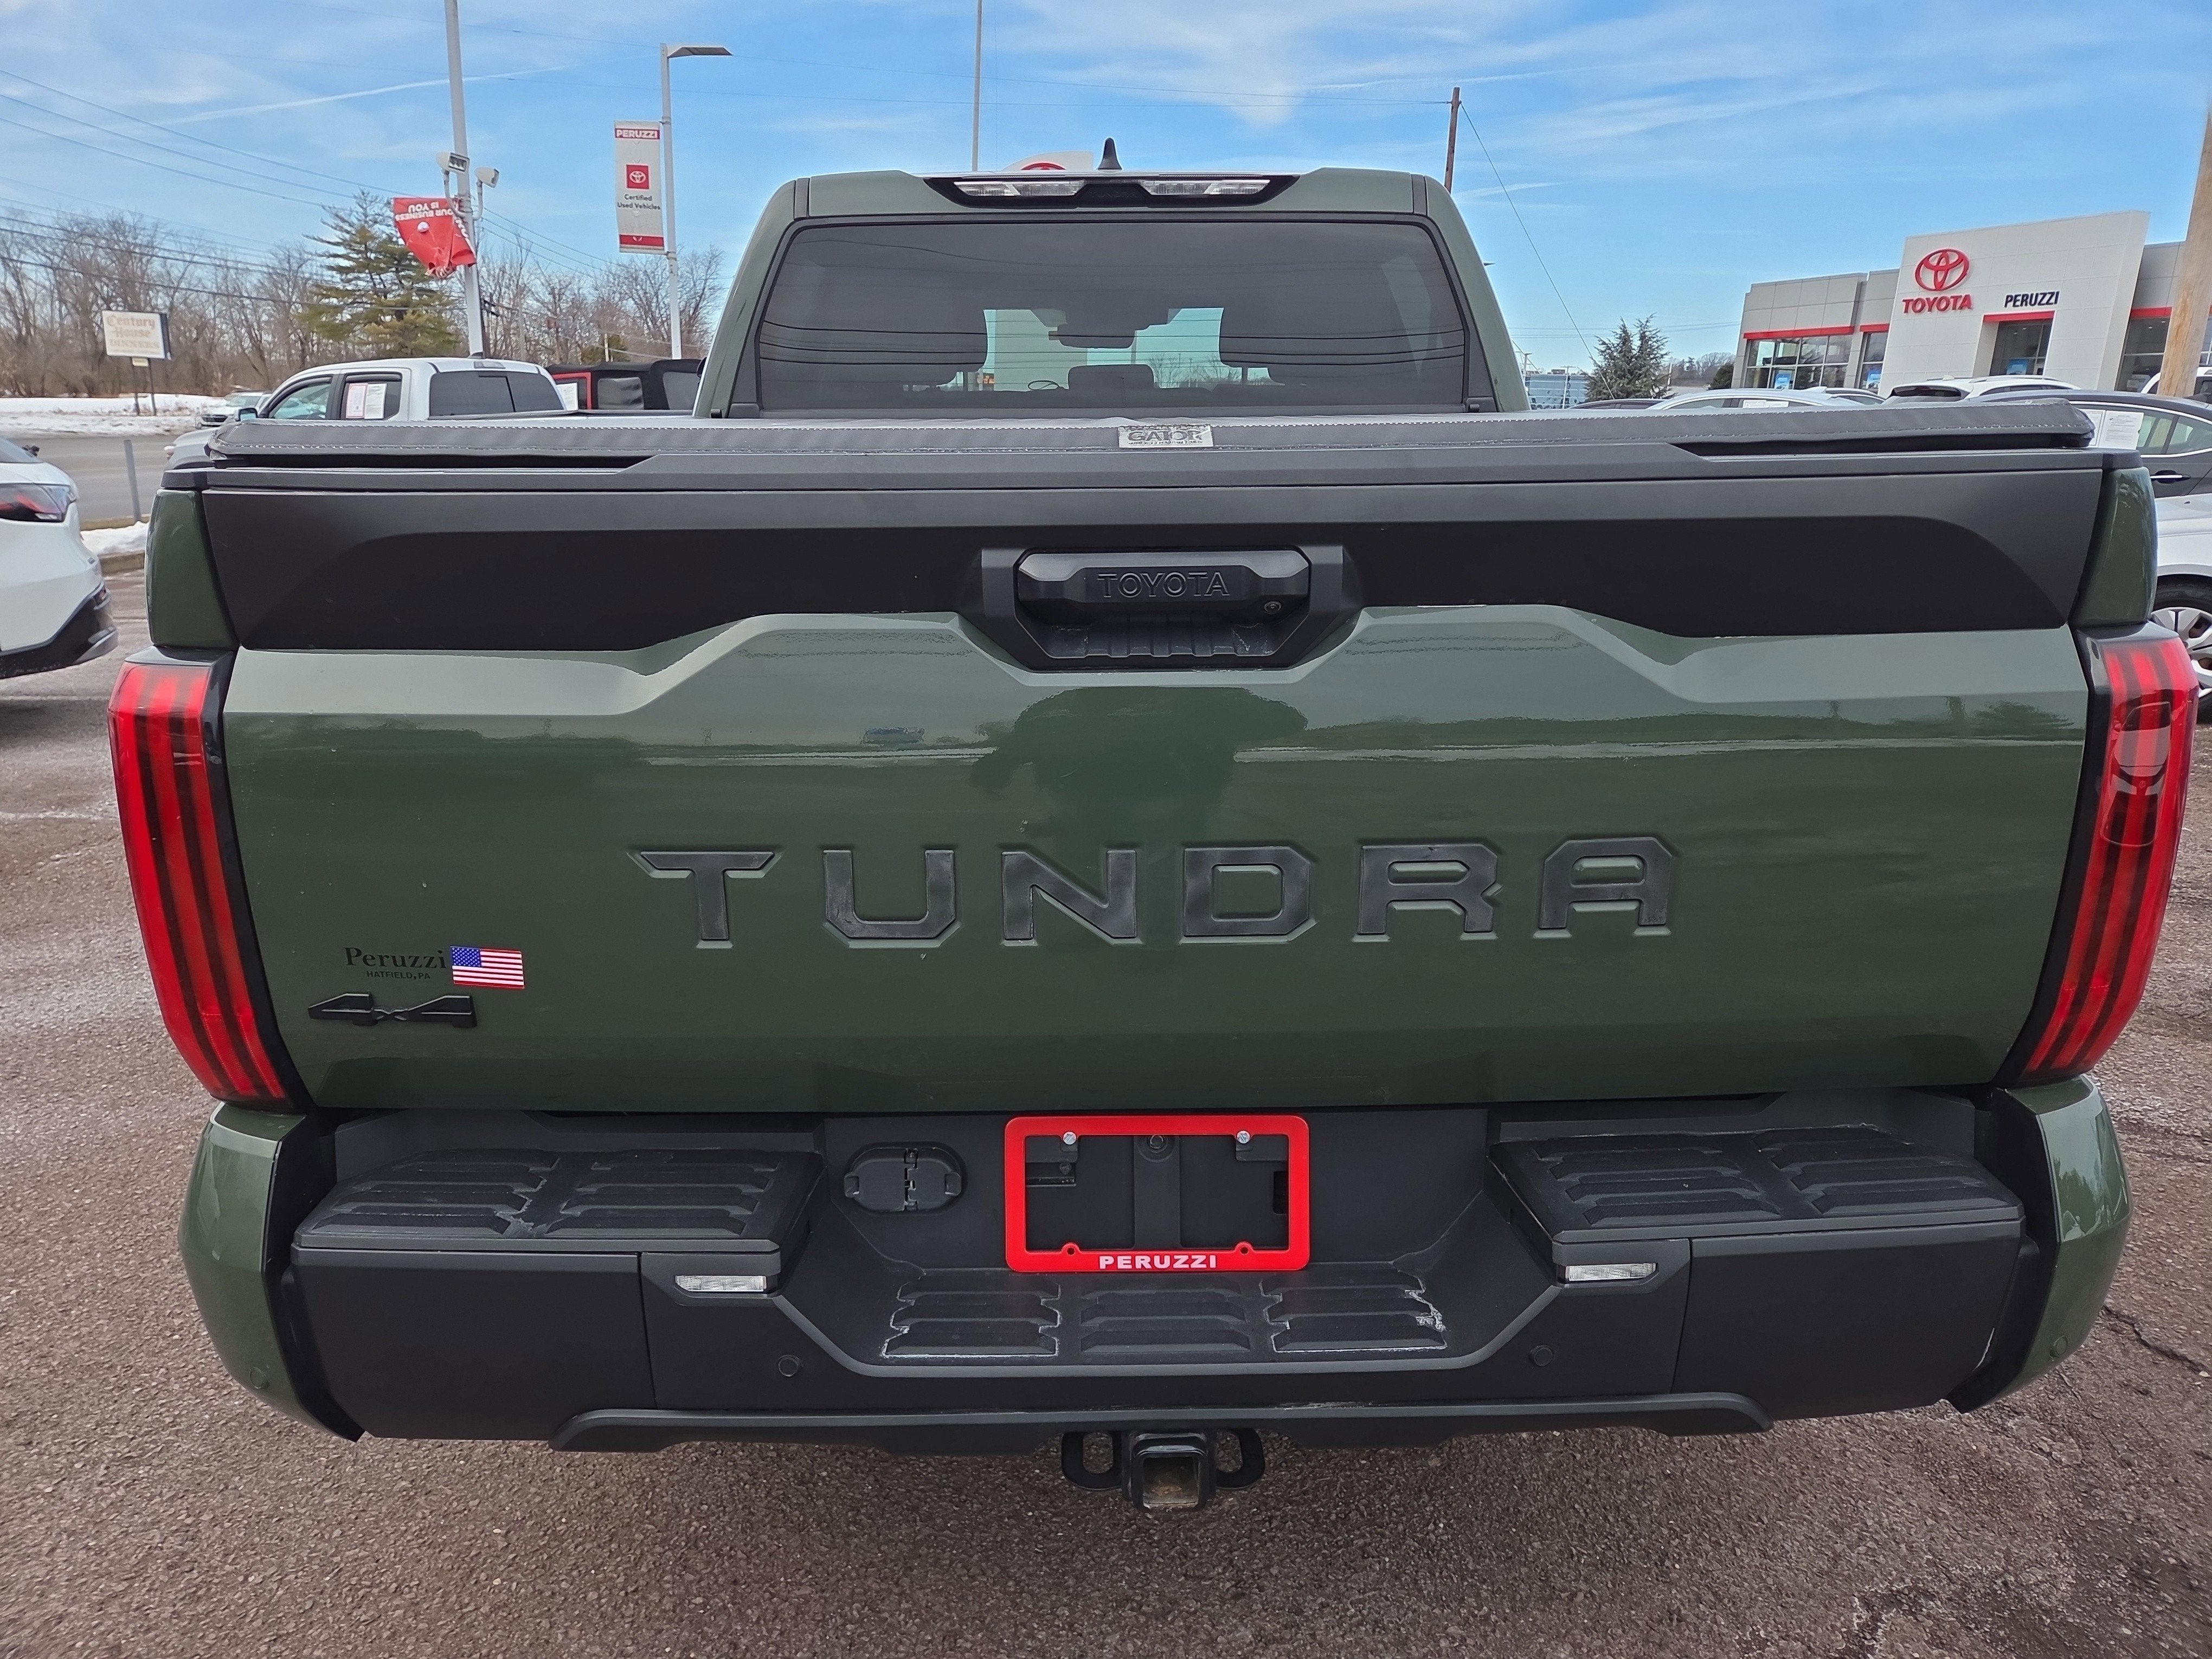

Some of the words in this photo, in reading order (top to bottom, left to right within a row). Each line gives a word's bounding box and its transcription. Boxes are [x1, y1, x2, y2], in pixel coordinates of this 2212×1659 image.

[616, 129, 658, 138] PERUZZI
[395, 210, 434, 221] BUSINESS
[408, 203, 429, 213] YOU
[1902, 294, 1972, 313] TOYOTA
[2004, 291, 2060, 308] PERUZZI
[106, 314, 155, 330] Century
[1097, 571, 1230, 599] TOYOTA
[633, 835, 1675, 944] TUNDRA
[343, 947, 447, 969] Peruzzi
[1099, 1254, 1217, 1270] PERUZZI
